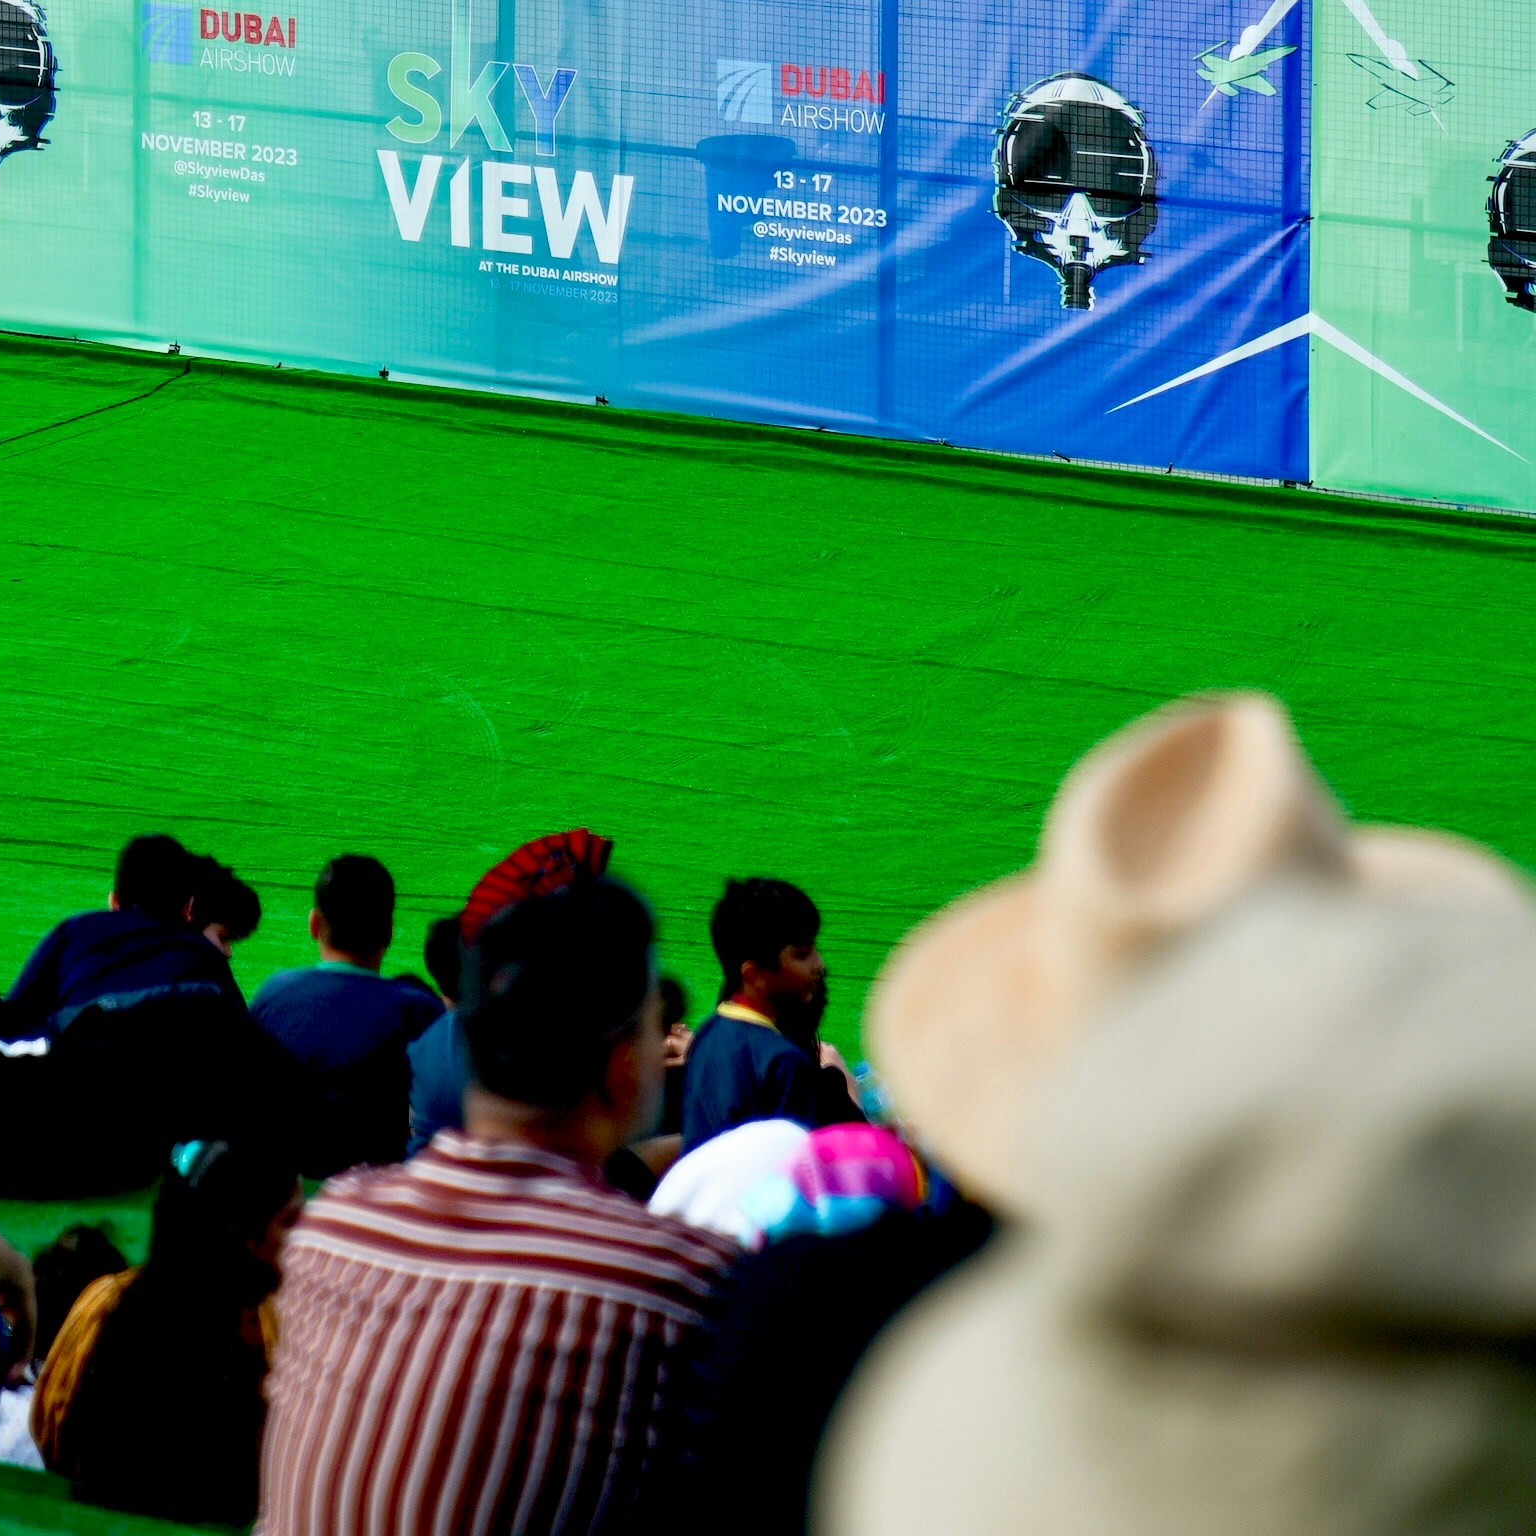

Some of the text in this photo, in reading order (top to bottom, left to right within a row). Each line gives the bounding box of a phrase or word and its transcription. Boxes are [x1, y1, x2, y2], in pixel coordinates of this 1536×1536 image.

[200, 8, 296, 48] DUBAI
[200, 47, 296, 77] AIRSHOW
[780, 63, 885, 104] DUBAI
[192, 111, 212, 129] 13
[227, 114, 246, 132] 17
[780, 103, 885, 135] AIRSHOW
[141, 132, 298, 166] NOVEMBER 2023
[174, 160, 265, 182] @SkyviewDas
[773, 170, 794, 189] 13
[812, 174, 832, 193] 17
[188, 184, 250, 203] #Skyview
[376, 150, 634, 264] VIEW
[717, 194, 887, 228] NOVEMBER 2023
[753, 222, 852, 245] @SkyviewDas
[769, 246, 836, 266] #Skyview
[478, 260, 618, 286] AT THE DUBAI AIRSHOW
[489, 278, 501, 290] 13
[510, 281, 520, 292] 17
[523, 282, 588, 300] NOVEMBER
[590, 289, 618, 304] 2023
